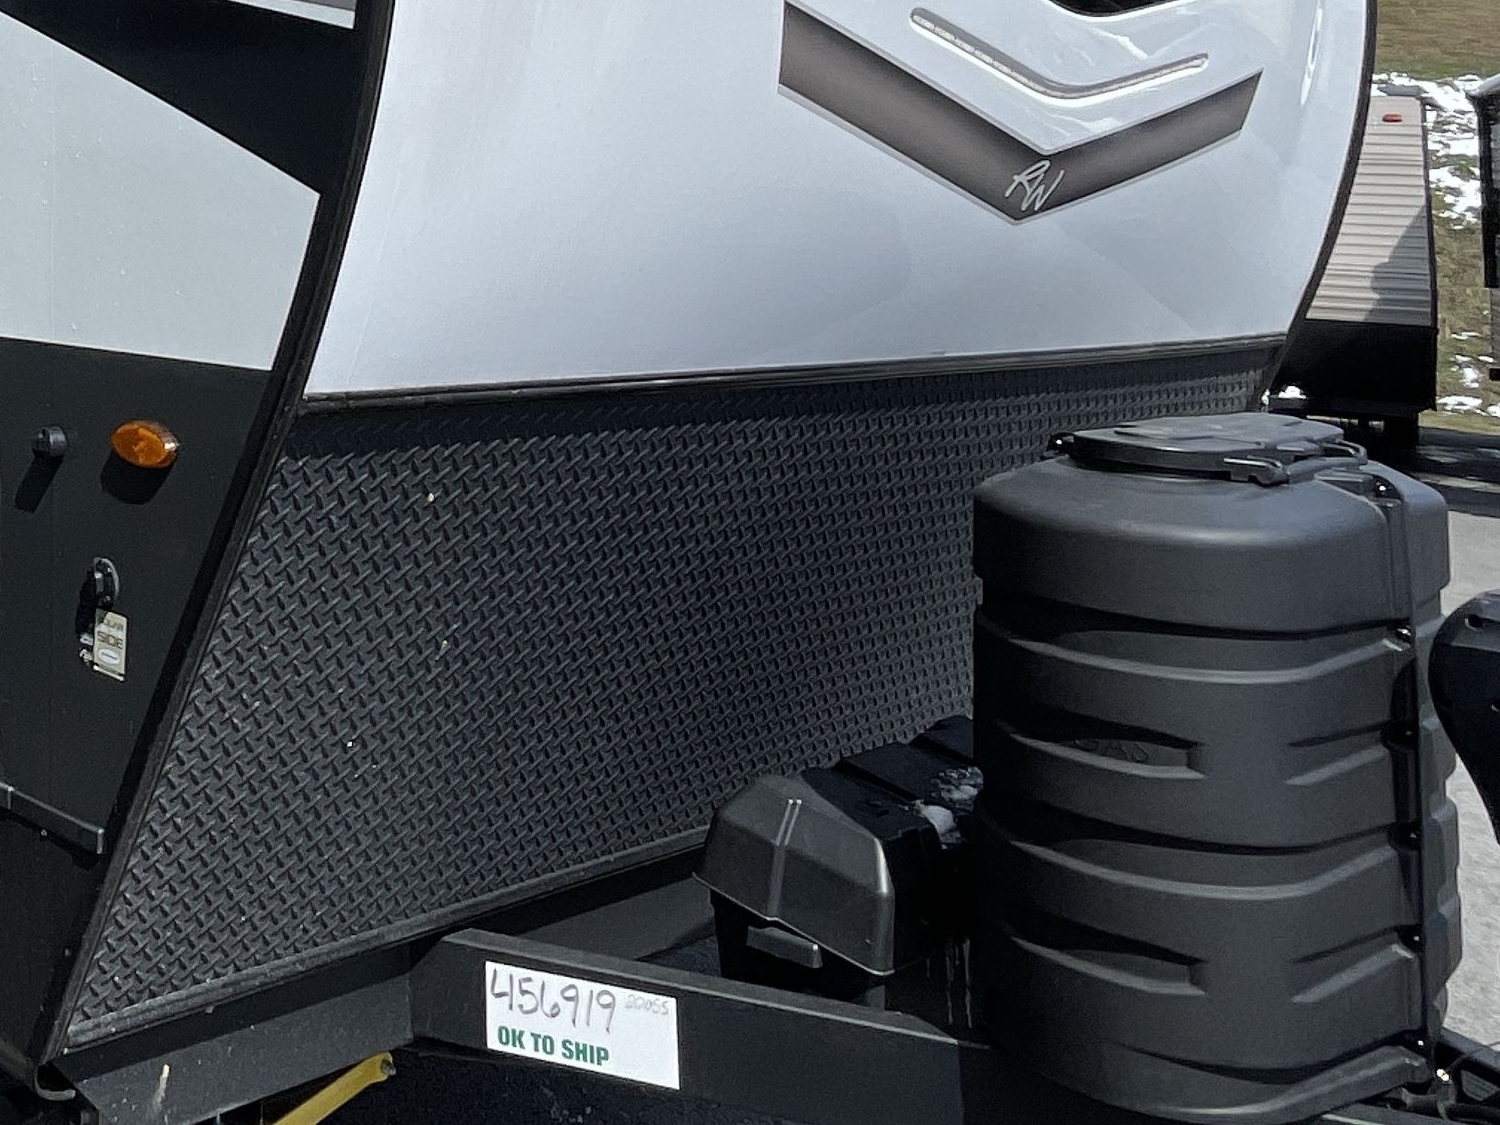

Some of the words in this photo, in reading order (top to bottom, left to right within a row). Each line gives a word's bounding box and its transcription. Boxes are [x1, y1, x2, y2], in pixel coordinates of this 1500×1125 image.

[491, 968, 616, 1034] 456919
[498, 1025, 526, 1050] OK
[530, 1031, 555, 1055] TO
[561, 1038, 609, 1066] SHIP
